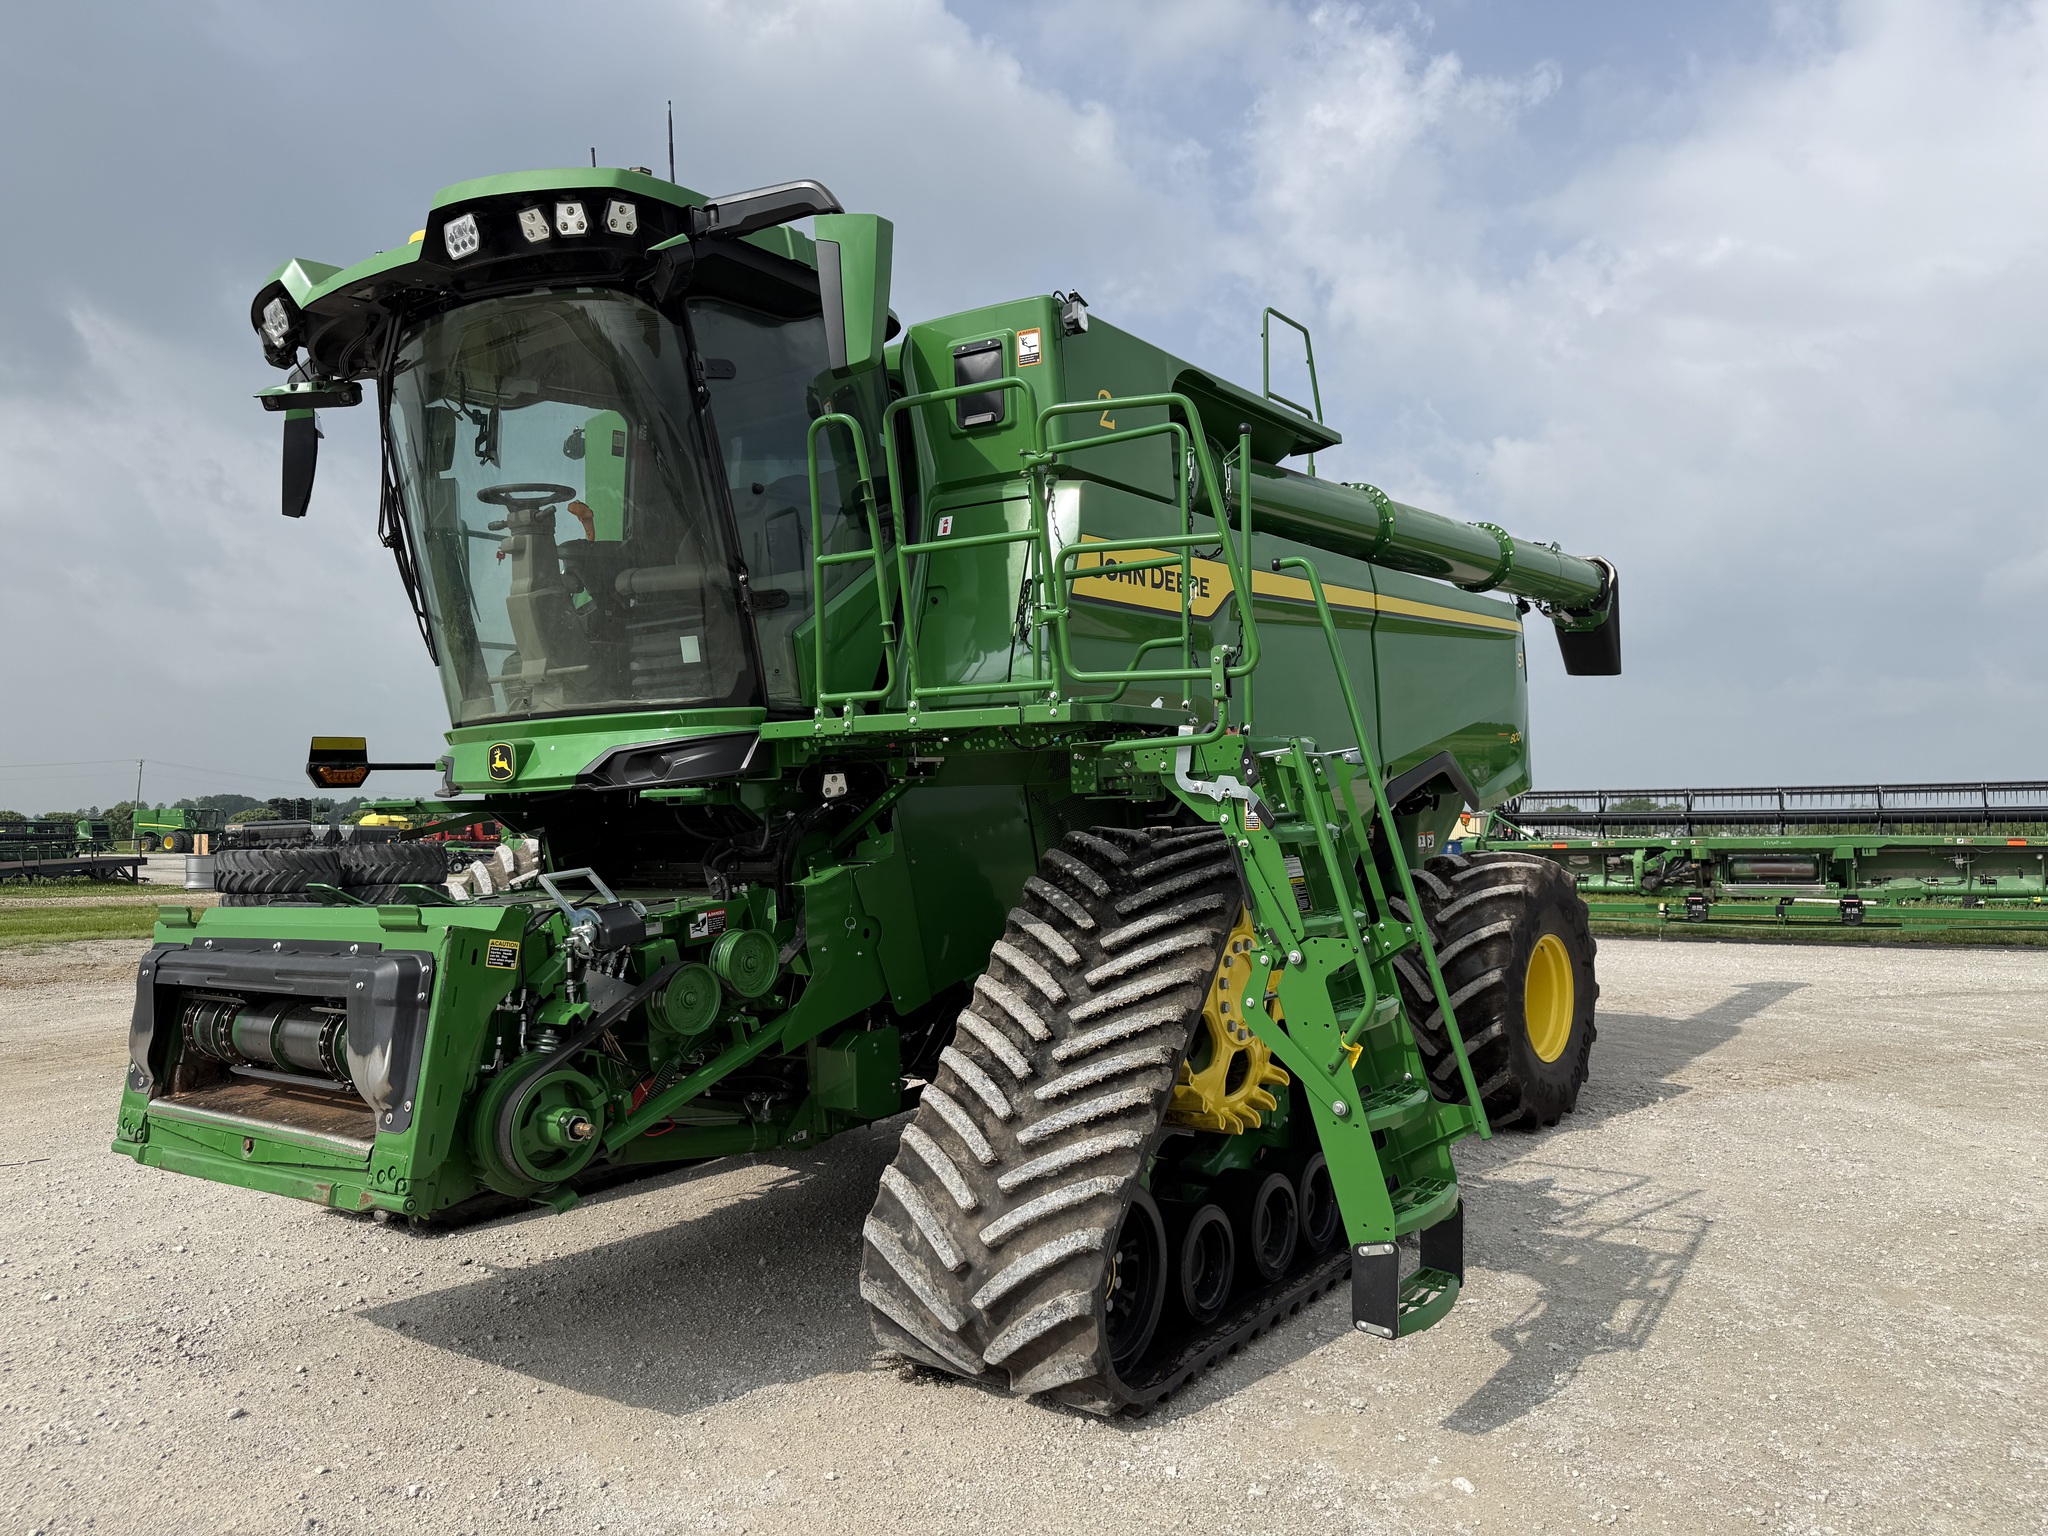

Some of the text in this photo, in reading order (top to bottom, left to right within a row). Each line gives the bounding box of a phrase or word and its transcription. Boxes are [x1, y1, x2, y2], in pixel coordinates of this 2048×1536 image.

[1098, 390, 1115, 430] 2
[1093, 552, 1146, 587] JOHN
[494, 940, 518, 948] CAUTION
